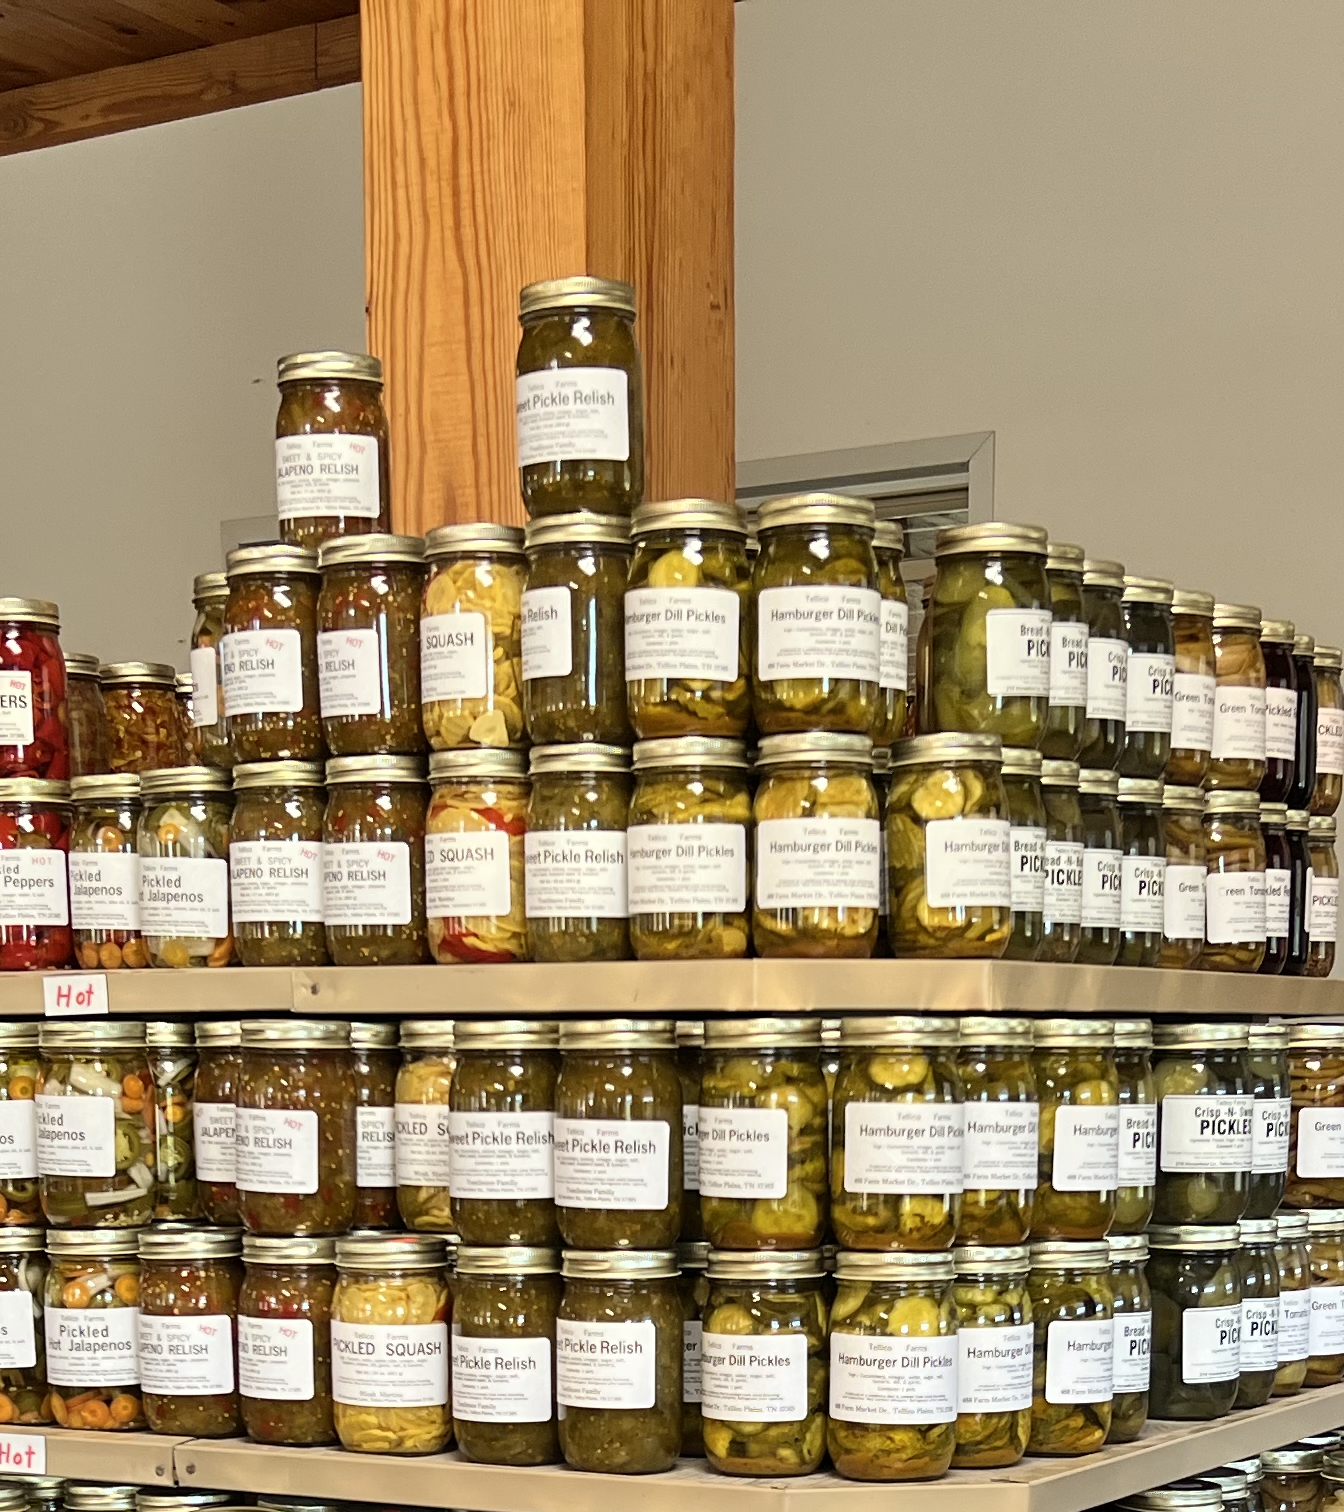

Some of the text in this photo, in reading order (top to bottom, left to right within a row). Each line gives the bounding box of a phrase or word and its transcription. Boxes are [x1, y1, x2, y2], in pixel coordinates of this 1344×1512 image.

[532, 392, 568, 407] Pickle
[771, 608, 834, 622] Hamburger
[425, 632, 474, 648] SQUASH
[440, 847, 495, 863] SQUASH
[770, 841, 832, 854] Hamburger
[56, 983, 96, 1008] Hot
[859, 1124, 926, 1140] Hamburger
[1199, 1119, 1252, 1137] PICKLES
[1314, 1120, 1342, 1132] Green
[471, 1131, 511, 1146] Pickle
[734, 1129, 770, 1143] Pickles
[68, 1338, 132, 1352] Jalapenos
[333, 1338, 442, 1356] PICKLED SQUASH
[966, 1344, 1024, 1361] Hamburger
[494, 1356, 536, 1370] Relish
[749, 1354, 791, 1368] Pickles
[838, 1352, 952, 1370] Hamburger Dill Pickles
